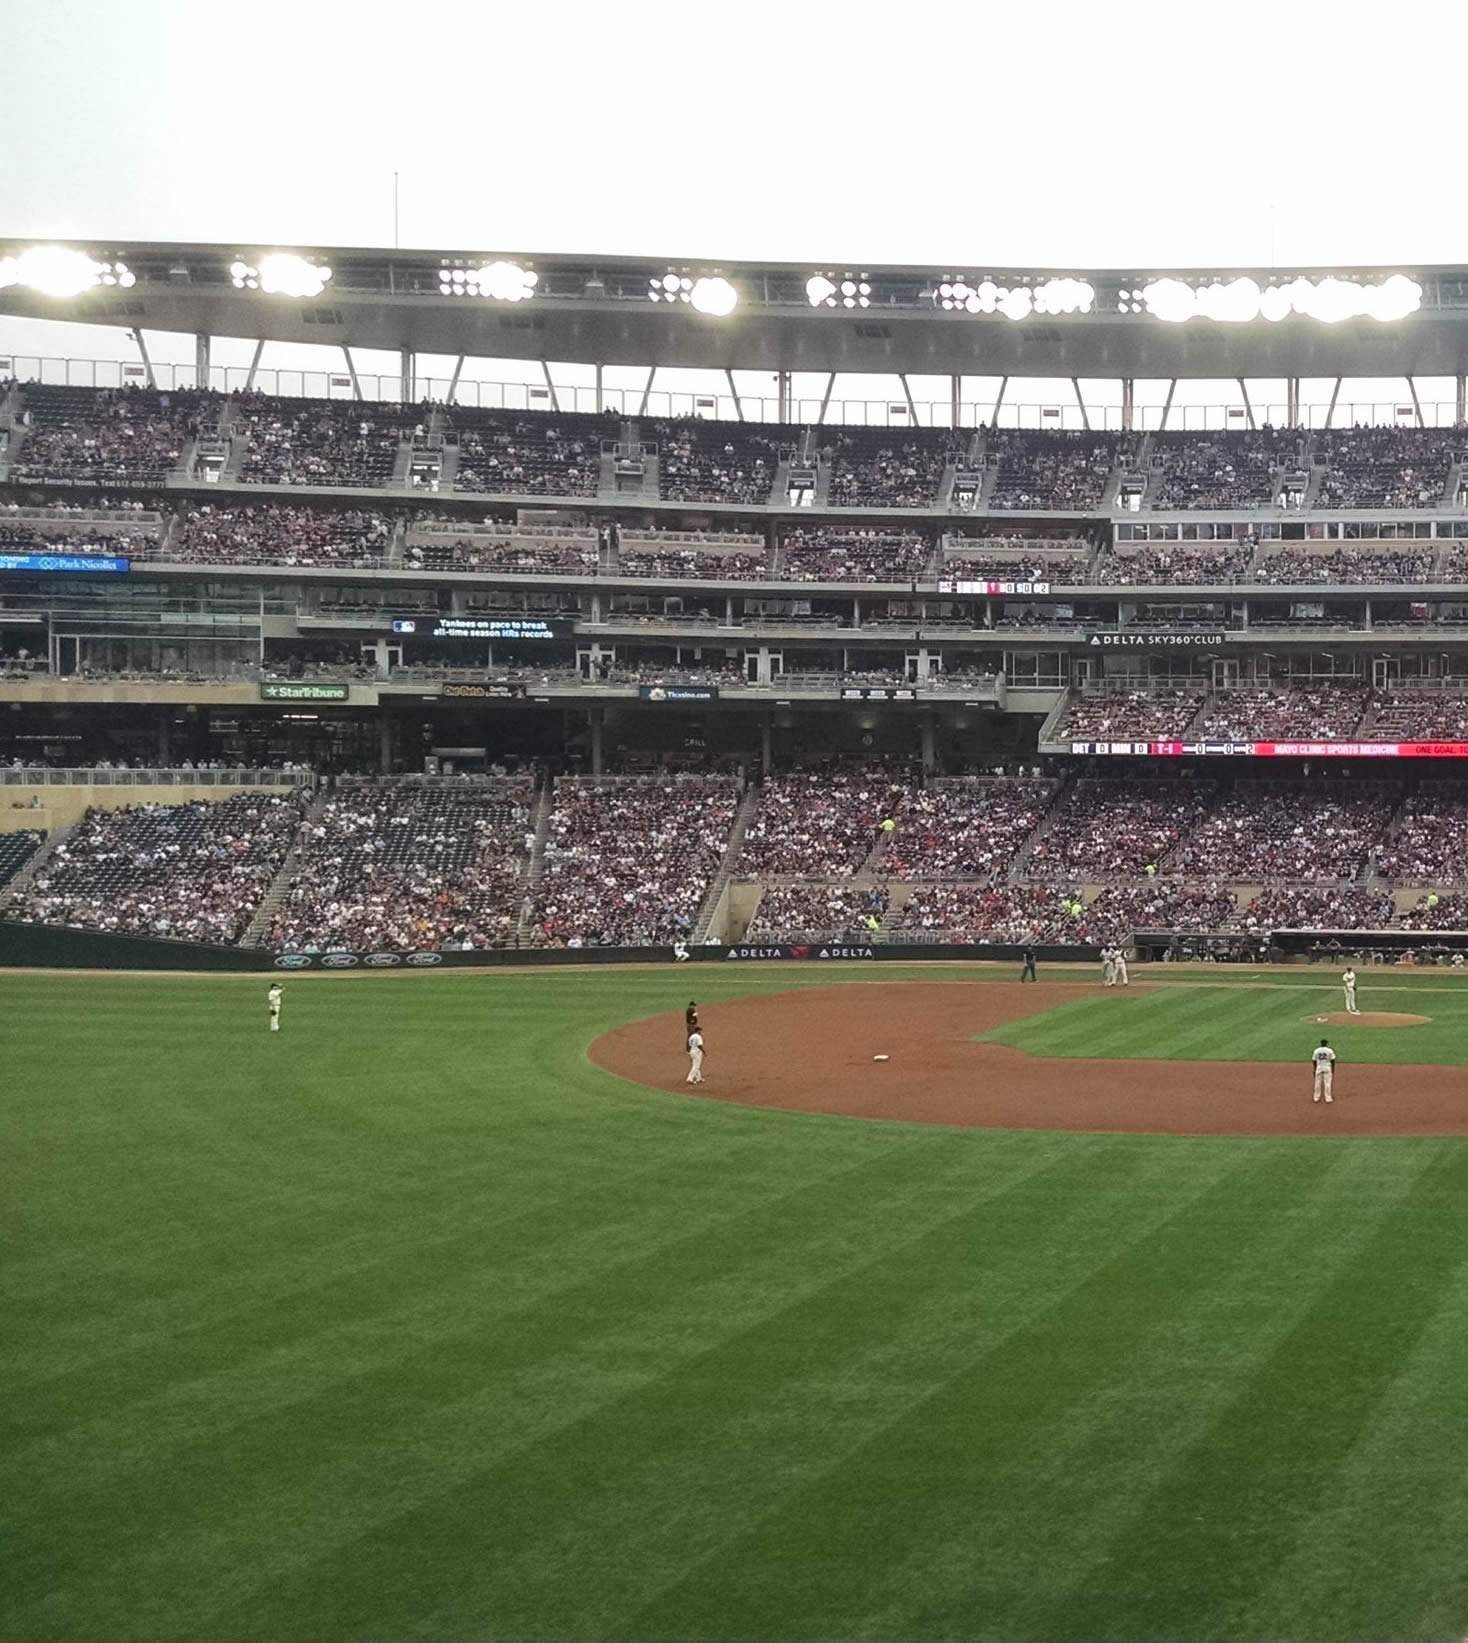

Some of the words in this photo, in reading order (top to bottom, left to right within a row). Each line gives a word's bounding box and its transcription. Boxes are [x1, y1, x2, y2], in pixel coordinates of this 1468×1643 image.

[44, 477, 72, 487] Security
[59, 559, 79, 570] Park
[82, 559, 116, 570] Nicollet
[439, 619, 476, 628] Yankees
[490, 621, 510, 631] pace
[512, 621, 521, 630] to
[522, 621, 547, 630] break
[433, 628, 469, 636] all-time
[502, 629, 519, 637] HRs
[521, 630, 553, 638] records
[1103, 635, 1144, 645] DELTA
[279, 687, 345, 698] StarTribune
[1072, 744, 1089, 753] DET
[1275, 745, 1297, 754] MAYO
[1299, 745, 1326, 754] CLINIC
[1327, 745, 1359, 754] SPORTS
[1360, 745, 1399, 754] MEDICINE
[1416, 745, 1433, 754] ONE
[741, 949, 781, 957] DELTA
[832, 948, 872, 957] DELTA
